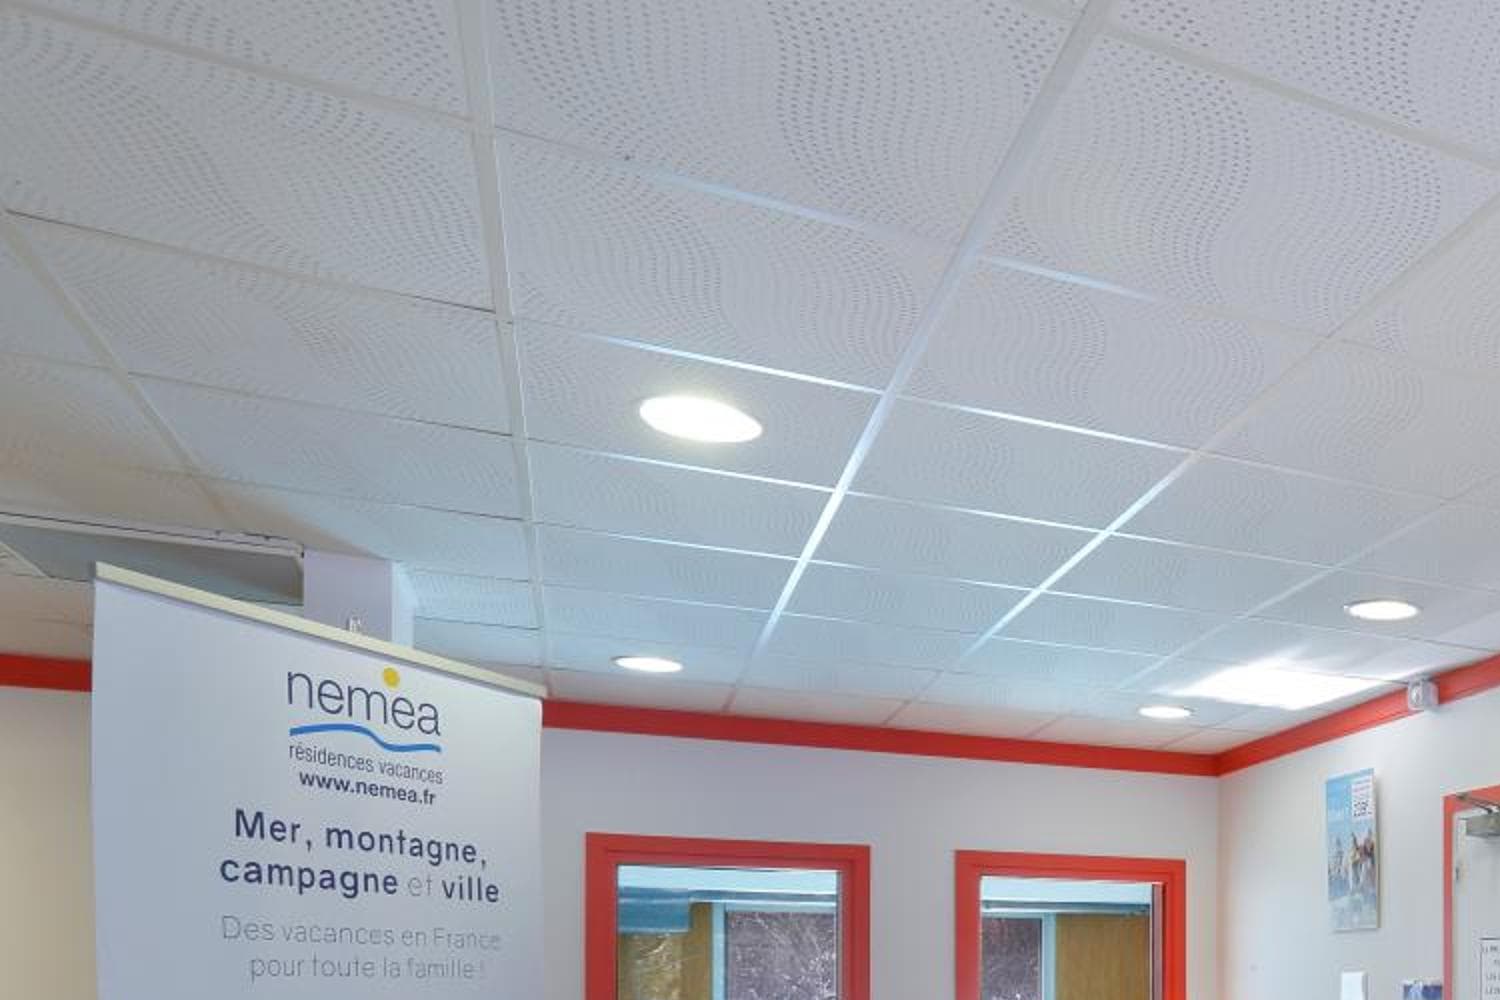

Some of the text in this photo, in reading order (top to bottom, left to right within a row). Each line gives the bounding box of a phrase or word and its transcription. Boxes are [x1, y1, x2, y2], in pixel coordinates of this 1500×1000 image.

[288, 743, 444, 785] résidences vacances
[299, 770, 436, 806] www.nemea.fr
[234, 807, 488, 873] Mer, montagne,
[219, 858, 500, 903] campagne et ville
[221, 914, 502, 951] Des vacances en France
[249, 956, 306, 985] pour
[311, 951, 376, 979] toute
[382, 955, 401, 979] la
[406, 955, 475, 980] famille
